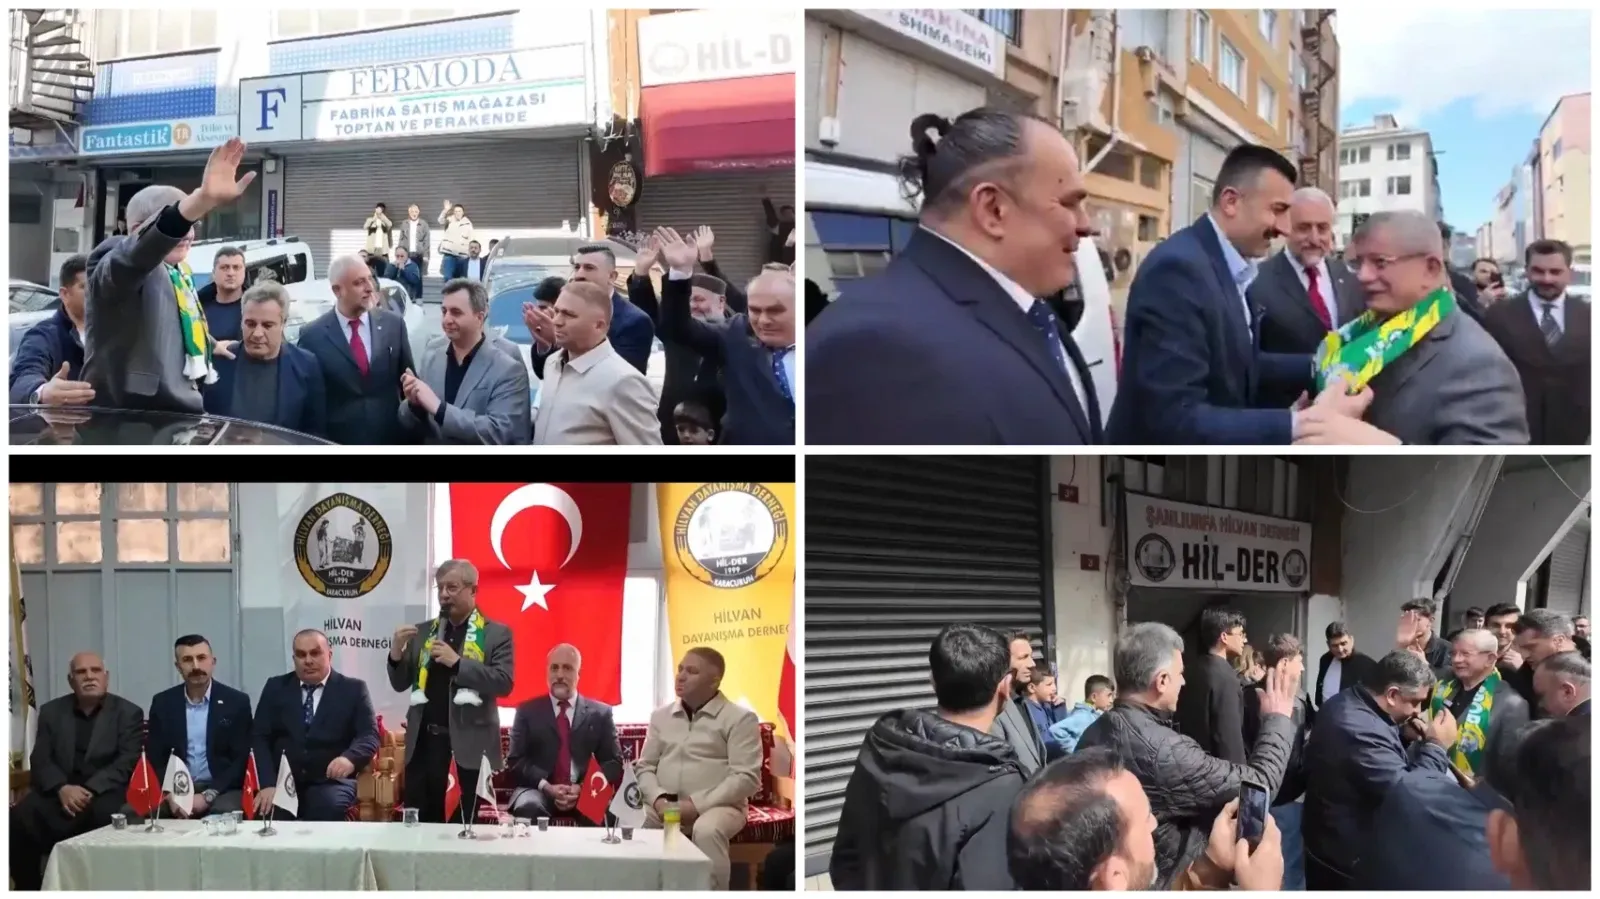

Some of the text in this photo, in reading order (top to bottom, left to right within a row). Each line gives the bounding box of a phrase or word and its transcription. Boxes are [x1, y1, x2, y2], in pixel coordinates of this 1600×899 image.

[350, 54, 523, 95] FERMODA
[256, 87, 286, 131] F
[330, 93, 545, 121] FABRİKA SATIŞ MAĞAZASI
[335, 111, 527, 136] TOPTAN VE PERAKENDE
[86, 127, 168, 149] Fantastik
[724, 566, 740, 574] 1999
[1183, 535, 1279, 583] HİL-DER
[324, 616, 361, 631] HİLVAN
[714, 608, 762, 624] HİLVAN
[682, 627, 745, 645] DAYANIŞMA
